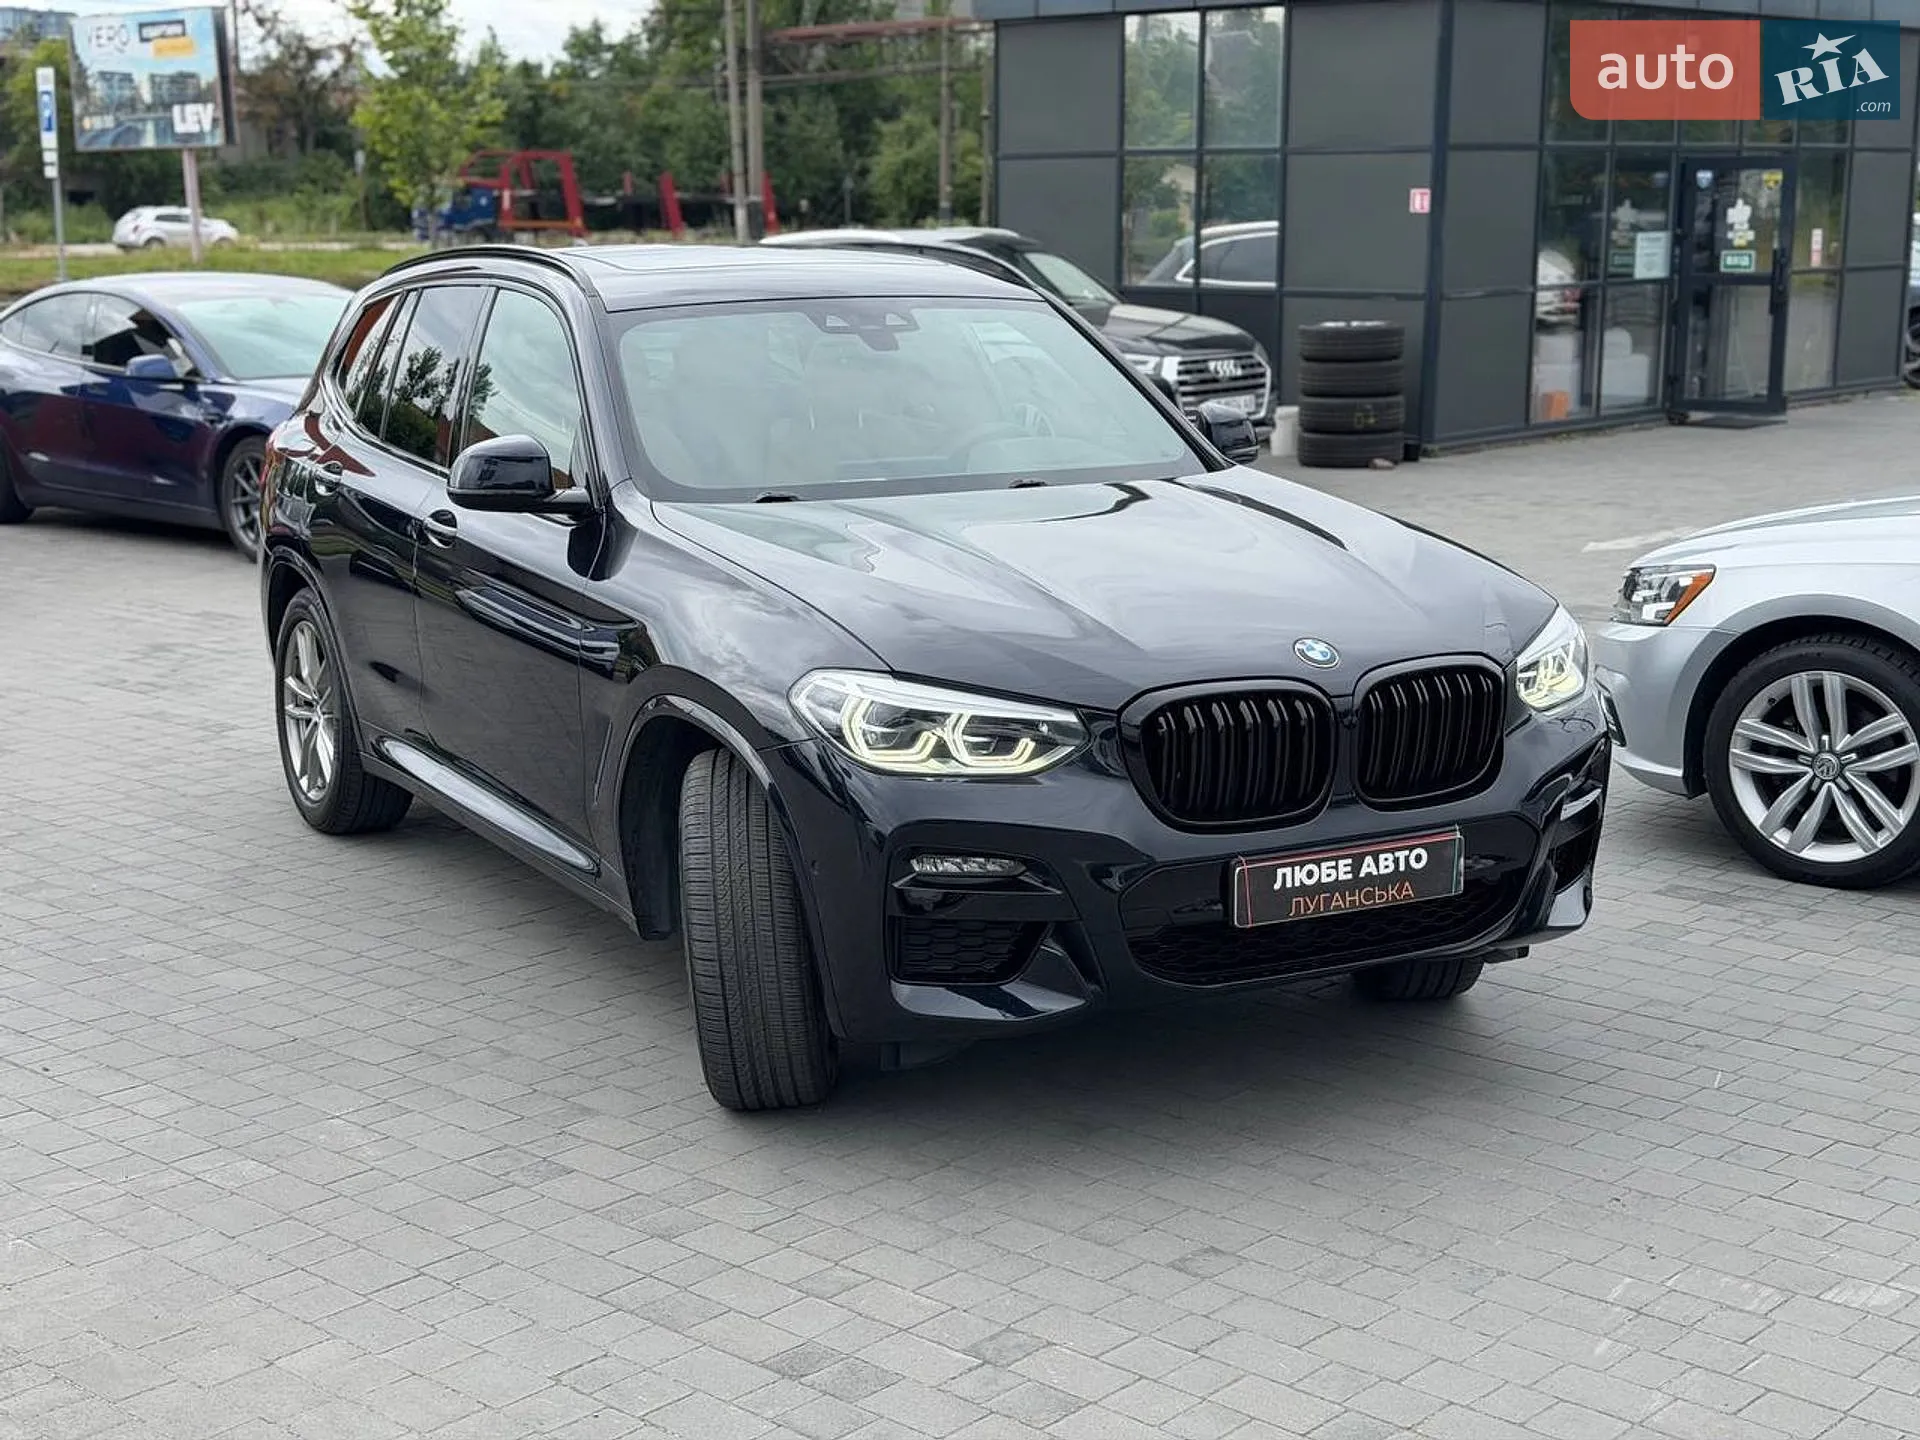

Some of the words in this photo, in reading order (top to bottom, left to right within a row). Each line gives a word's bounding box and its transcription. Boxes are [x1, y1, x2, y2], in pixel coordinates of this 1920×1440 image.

[1273, 858, 1352, 890] ЛЮБЕ
[1359, 847, 1428, 877] АВТО
[1289, 879, 1415, 916] ЛУГАНСЬКА
